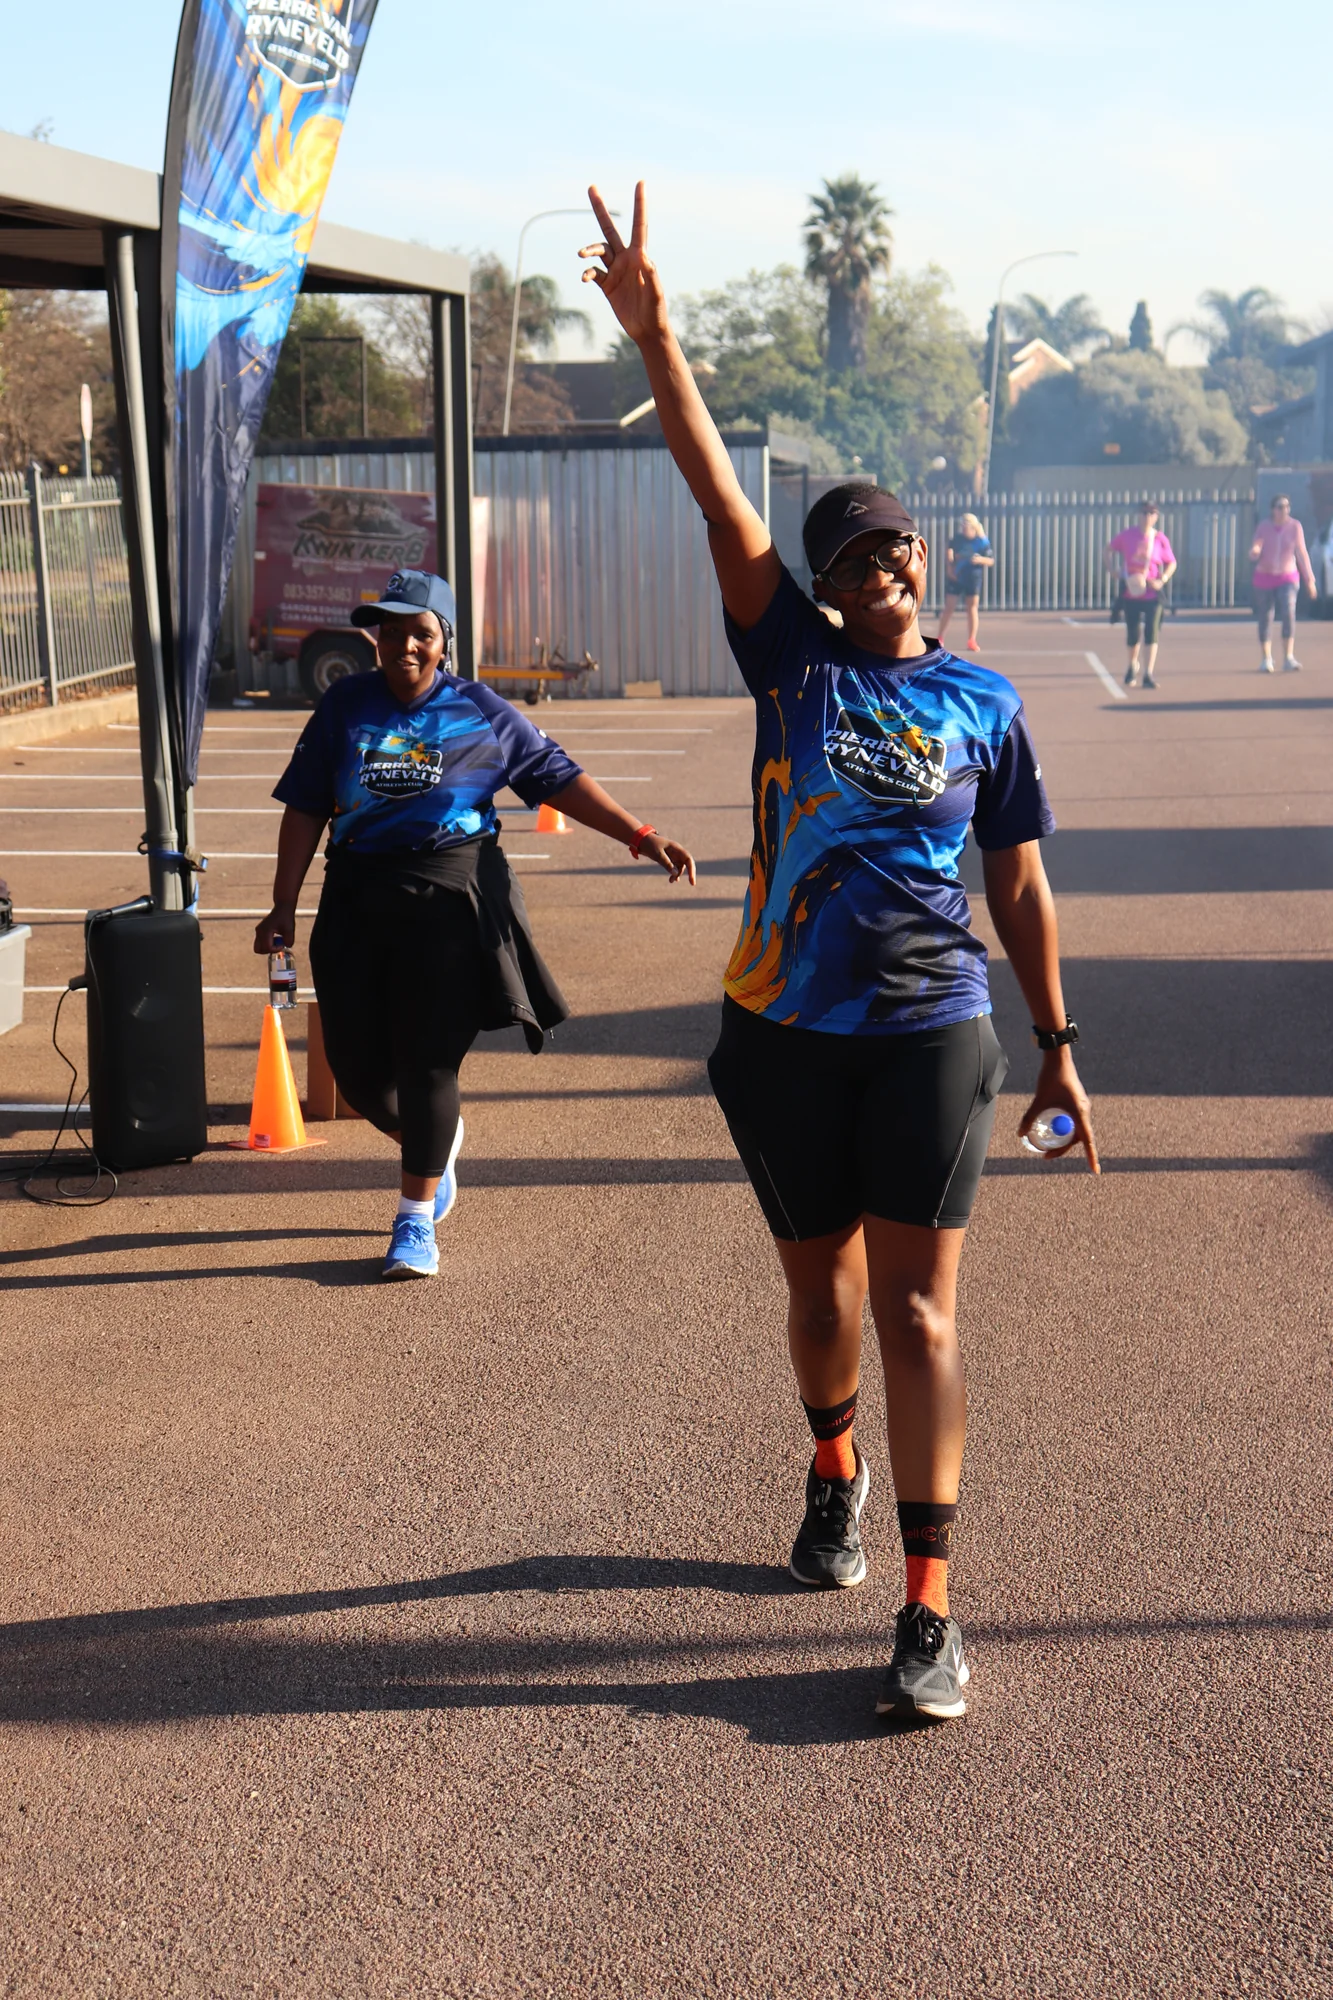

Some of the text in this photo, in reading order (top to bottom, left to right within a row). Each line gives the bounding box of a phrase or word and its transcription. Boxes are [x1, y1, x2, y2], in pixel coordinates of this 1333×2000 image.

[245, 15, 349, 69] RYNEVELD
[246, 0, 353, 48] PIERRE VAN
[293, 531, 355, 558] KWIK
[361, 539, 424, 569] KERB
[359, 762, 443, 775] PIERRE VAN
[824, 741, 946, 794] RYNEVELD
[826, 729, 948, 780] PIERRE VAN
[360, 769, 441, 784] RYNEVELD
[843, 762, 920, 792] ATHLETICS CLUB
